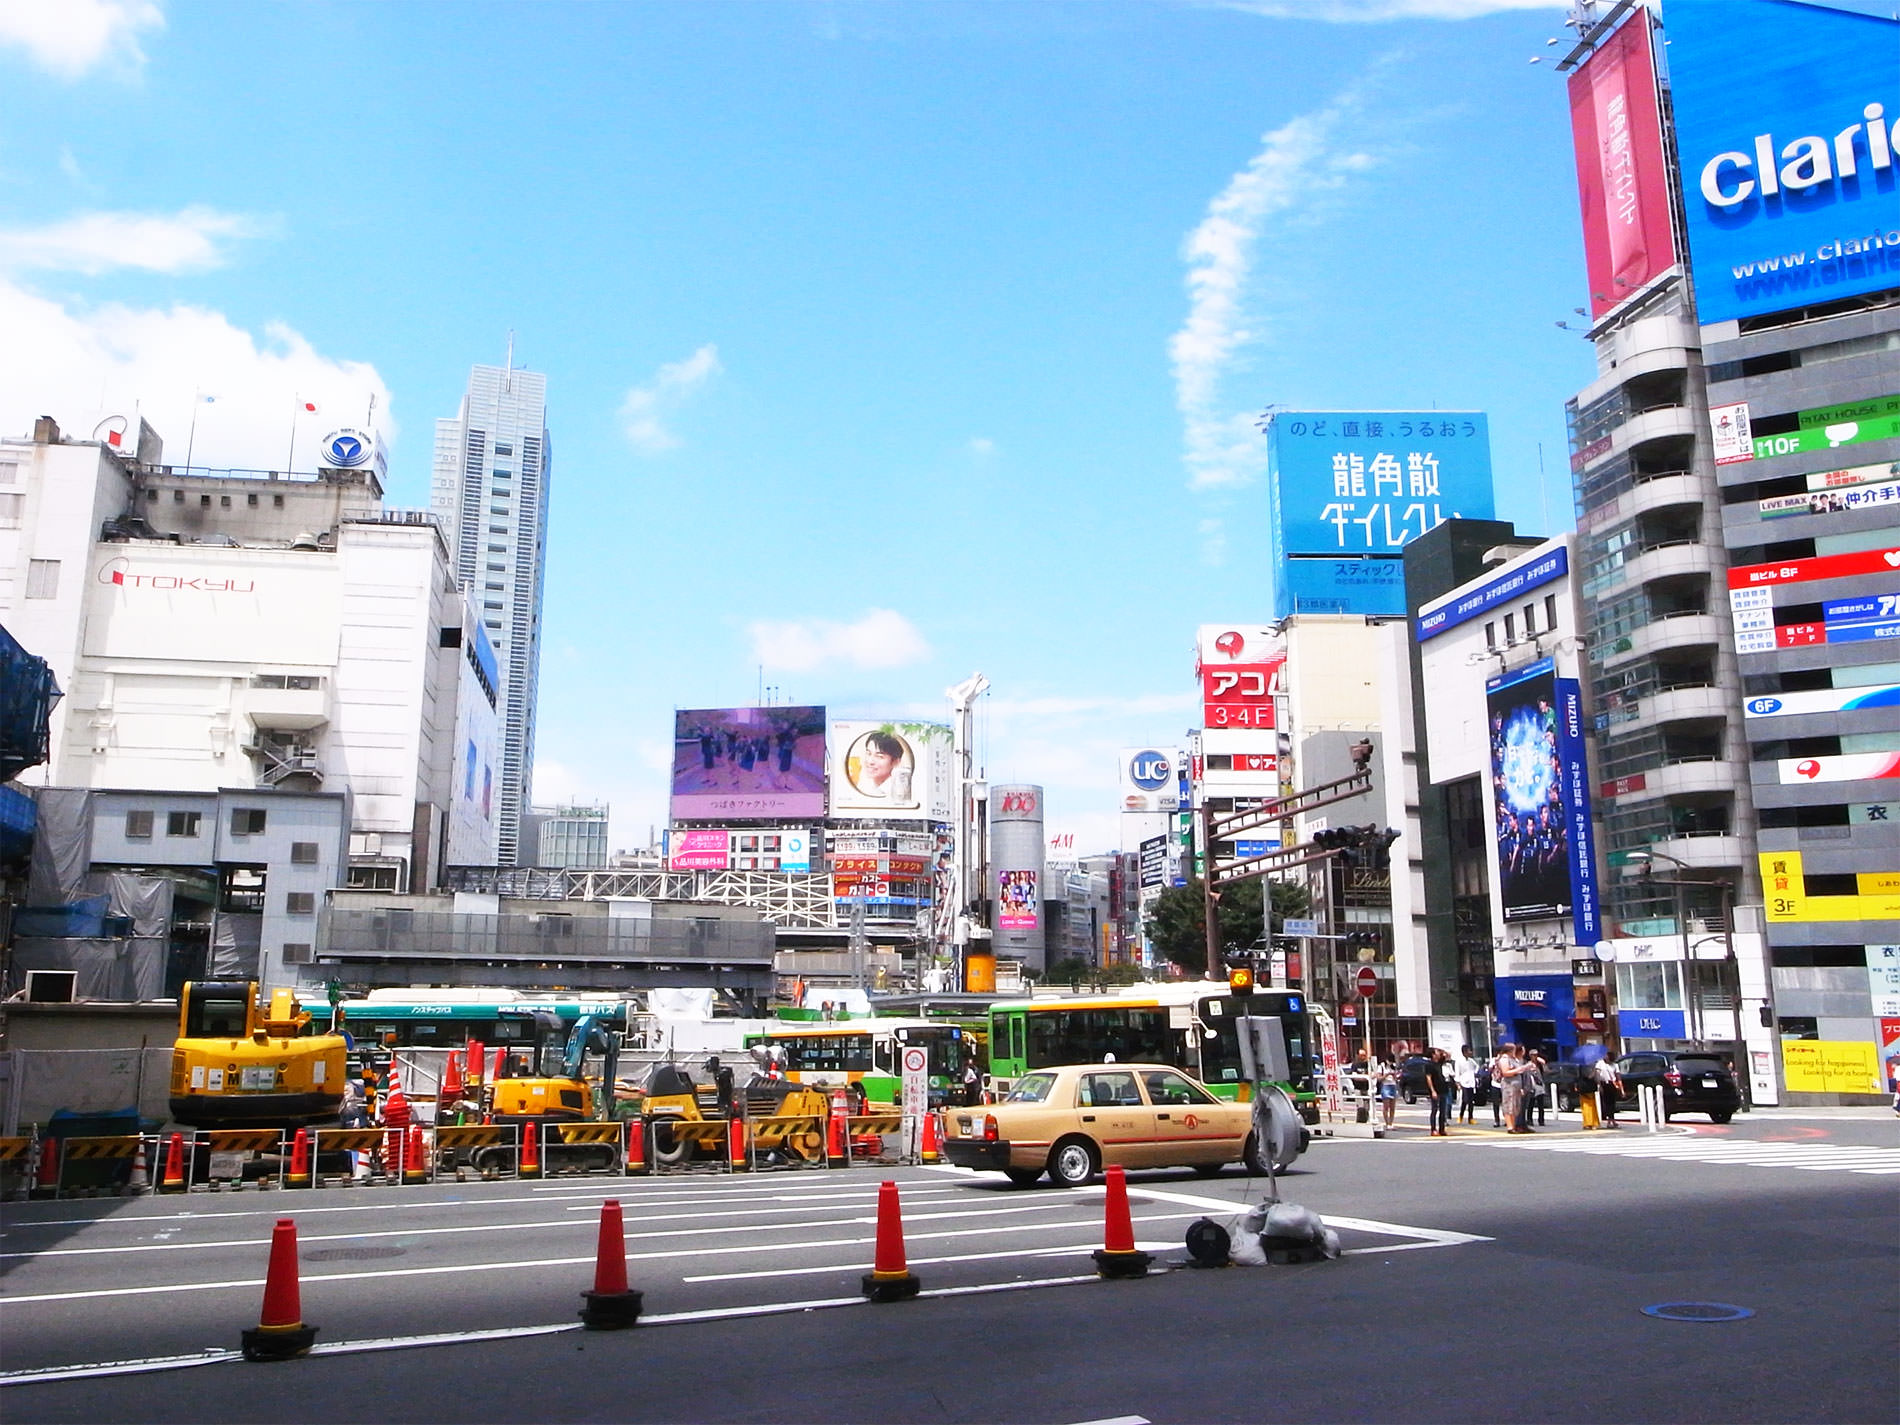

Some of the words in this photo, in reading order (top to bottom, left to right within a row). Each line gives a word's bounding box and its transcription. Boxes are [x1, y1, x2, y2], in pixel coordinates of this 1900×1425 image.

[1701, 103, 1900, 206] clari
[1290, 421, 1476, 438] のど、直接、うるおう
[1764, 438, 1800, 456] 10F
[1332, 452, 1440, 497] 龍角散
[1845, 484, 1900, 507] 仲介手
[126, 575, 254, 593] TOKYU
[1878, 595, 1900, 616] ア
[1755, 700, 1775, 712] 6F
[1567, 694, 1578, 738] MIZUHO
[1002, 796, 1035, 816] 109
[836, 860, 876, 869] プライス
[890, 861, 922, 870] コンタクト
[1774, 898, 1796, 913] 3F
[1634, 945, 1653, 957] DHC
[1514, 989, 1547, 1001] MIZUHO
[1640, 1018, 1661, 1030] DHC
